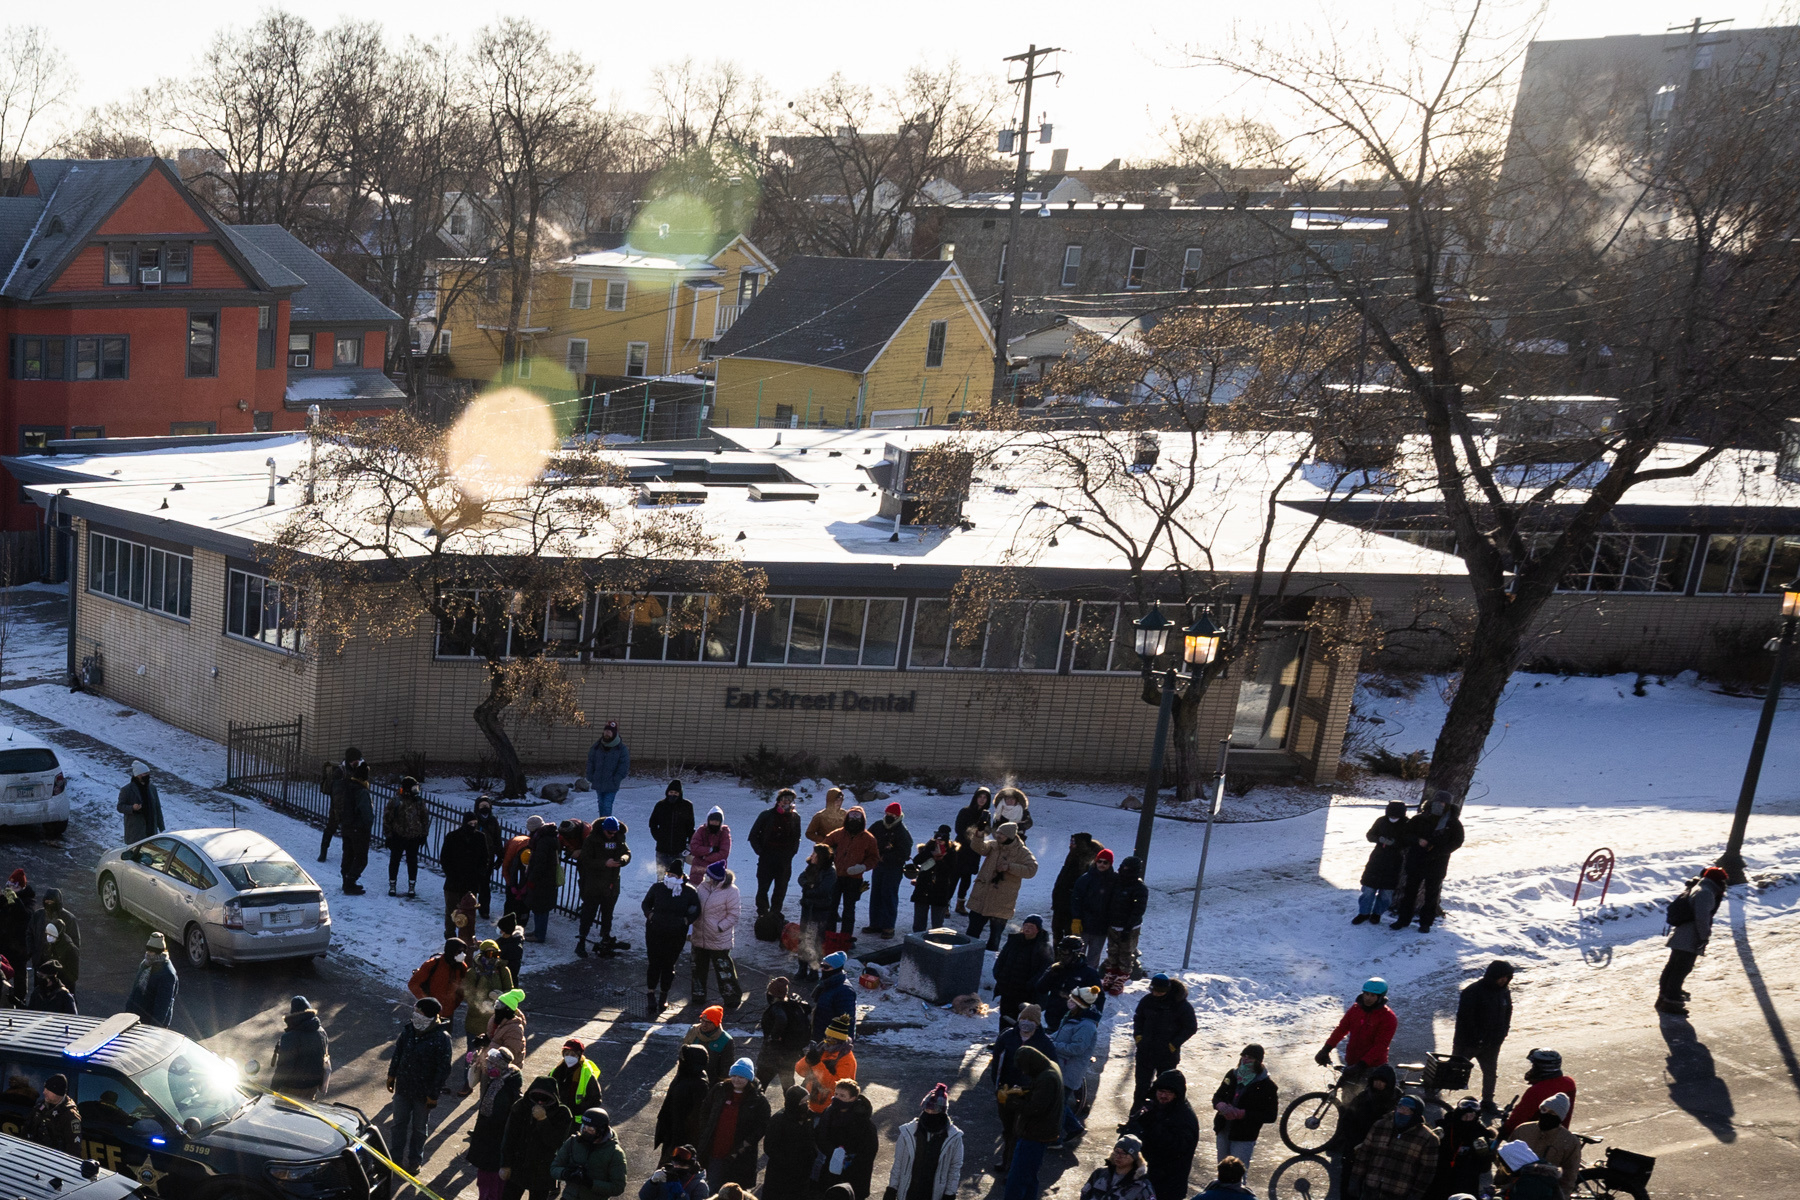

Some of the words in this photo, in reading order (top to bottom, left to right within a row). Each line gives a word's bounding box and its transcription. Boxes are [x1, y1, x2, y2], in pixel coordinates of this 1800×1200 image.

[726, 687, 759, 709] Eat
[765, 688, 837, 710] Street
[841, 690, 915, 712] Dental
[184, 1143, 210, 1156] 85199
